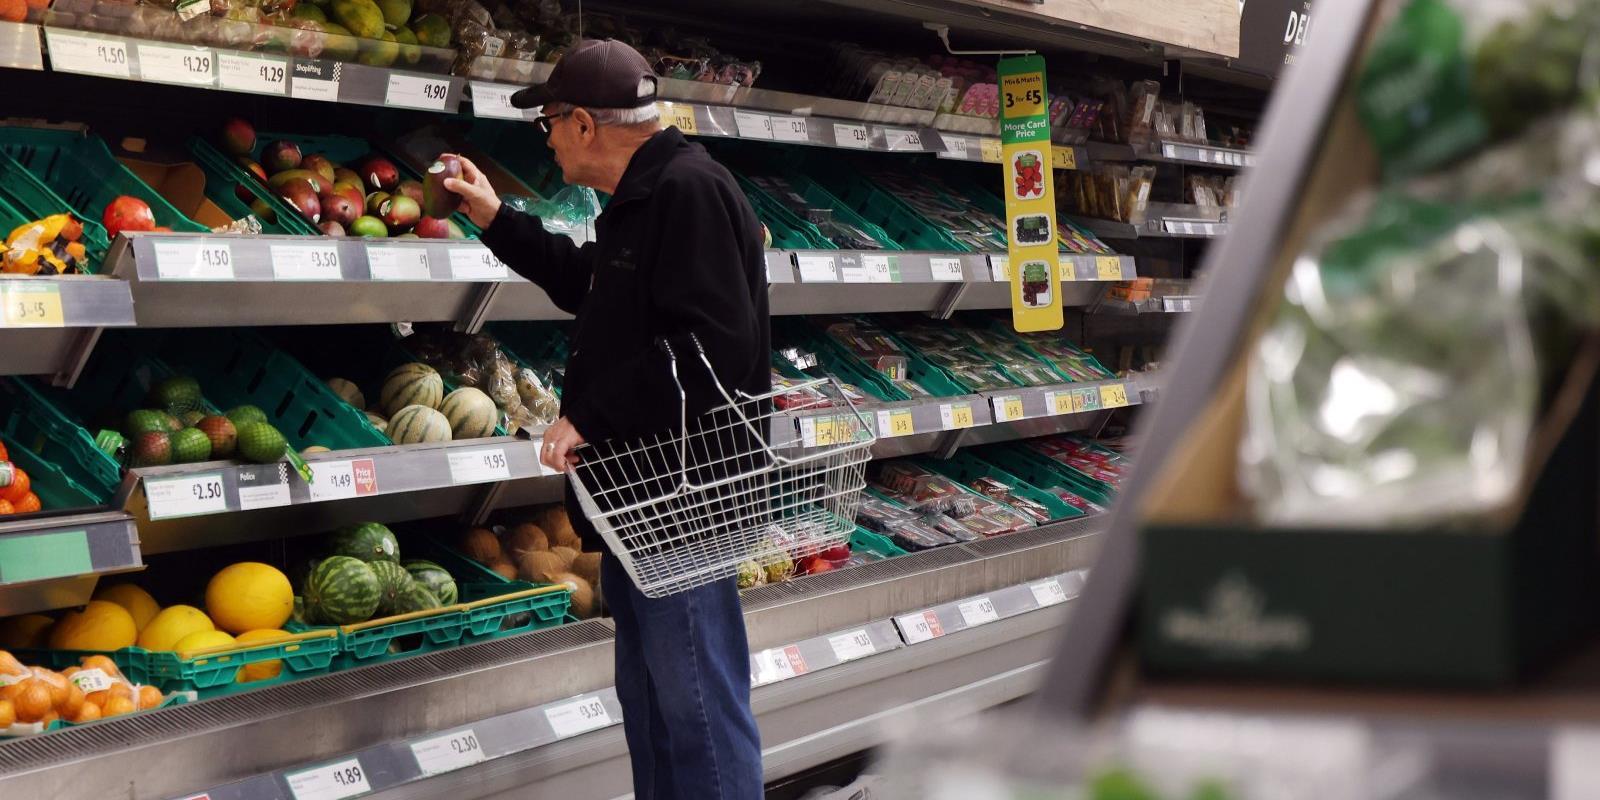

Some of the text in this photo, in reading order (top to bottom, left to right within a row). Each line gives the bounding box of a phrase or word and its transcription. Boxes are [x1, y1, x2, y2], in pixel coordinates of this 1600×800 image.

[98, 46, 125, 64] £1.50
[183, 55, 210, 73] £1.29
[295, 63, 322, 75] Shoplifting
[260, 65, 284, 83] £1.29
[424, 84, 447, 99] £1.90
[1005, 90, 1042, 108] 3 for £5
[1004, 119, 1046, 132] More Card
[1015, 129, 1036, 138] Price
[202, 249, 229, 267] £1.50
[311, 250, 337, 267] £3.50
[420, 254, 428, 268] £1
[19, 302, 26, 318] 3
[34, 302, 45, 317] £5
[484, 454, 505, 469] £1.95
[239, 472, 256, 482] Police
[331, 474, 351, 488] £1.49
[192, 482, 221, 500] £2.50
[579, 702, 604, 719] £3.50
[450, 735, 478, 753] £2.30
[334, 766, 362, 786] £1.89
